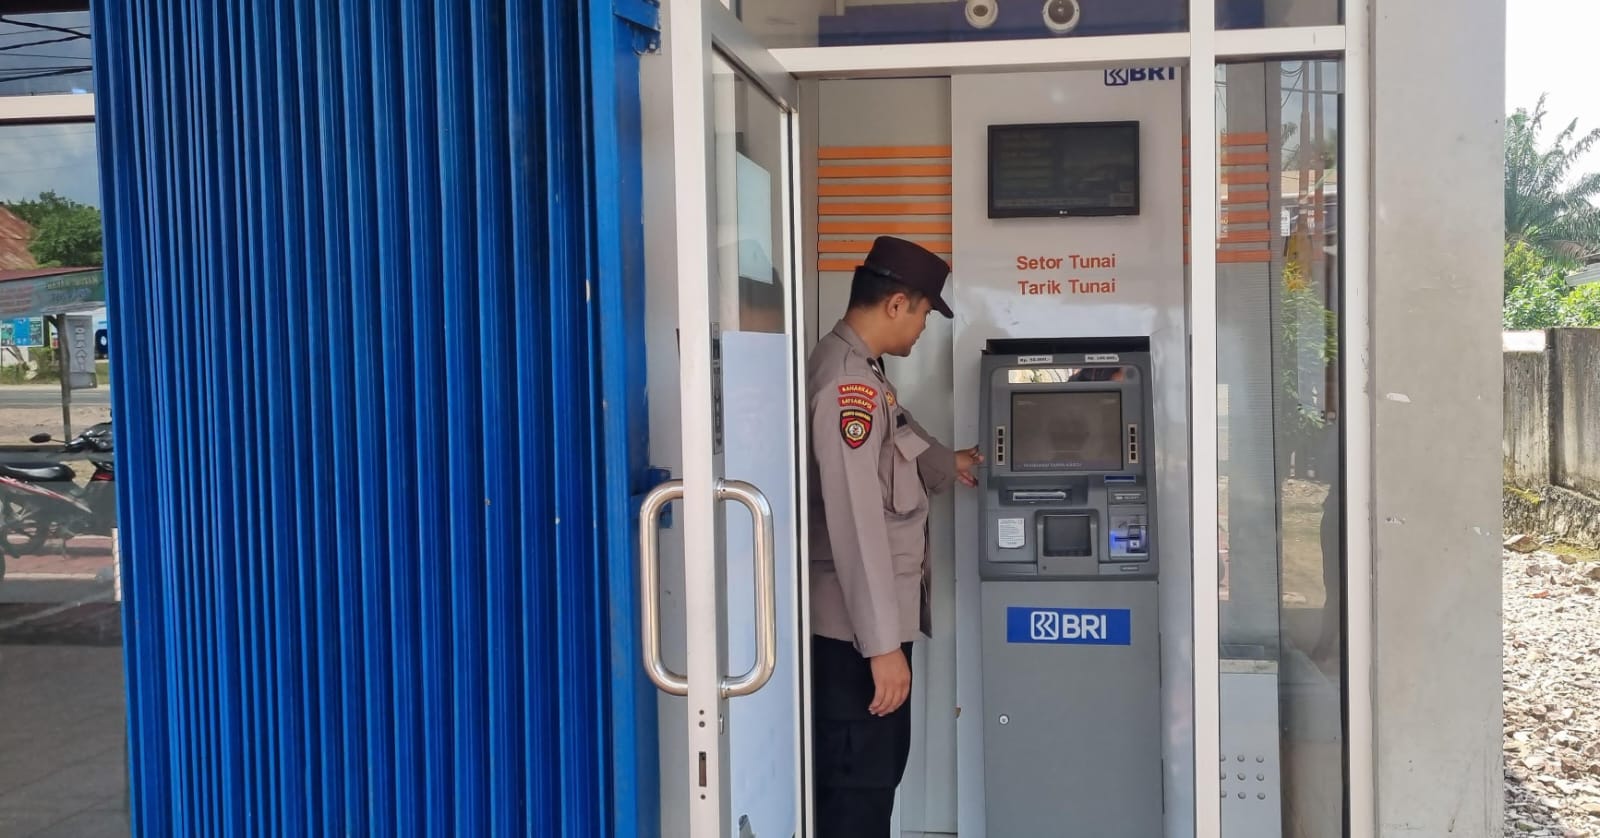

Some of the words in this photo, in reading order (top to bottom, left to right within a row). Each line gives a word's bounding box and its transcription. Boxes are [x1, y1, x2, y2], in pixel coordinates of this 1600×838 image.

[1130, 66, 1175, 82] BRI
[1016, 255, 1063, 271] Setor
[1068, 253, 1116, 270] Tunai
[1017, 279, 1061, 296] Tarik
[1068, 277, 1116, 294] Tunai
[1062, 614, 1107, 640] BRI
